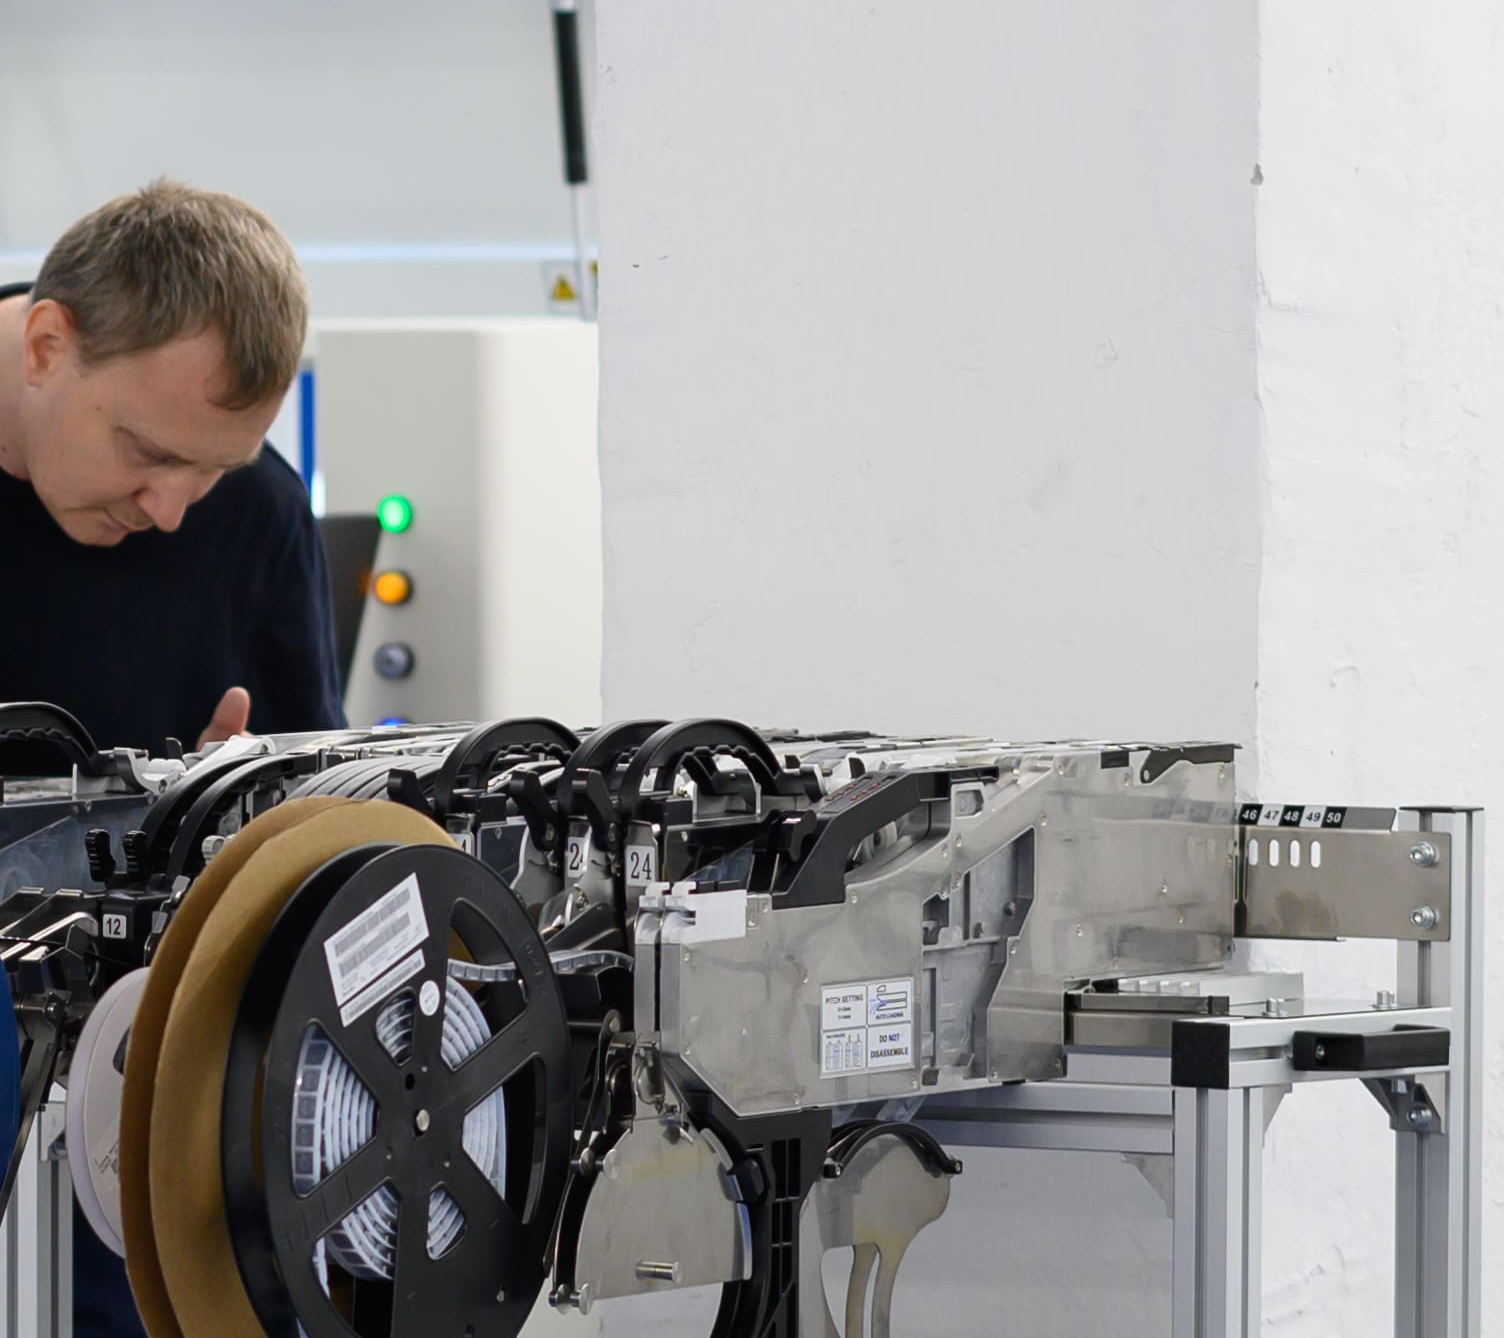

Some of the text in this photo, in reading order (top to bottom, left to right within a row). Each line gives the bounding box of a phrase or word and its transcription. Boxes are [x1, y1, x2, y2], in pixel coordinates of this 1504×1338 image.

[1242, 808, 1342, 824] 46 47 48 49 50
[569, 843, 584, 871] 2
[630, 851, 653, 880] 24
[106, 918, 121, 935] 12
[888, 1033, 900, 1042] NOT
